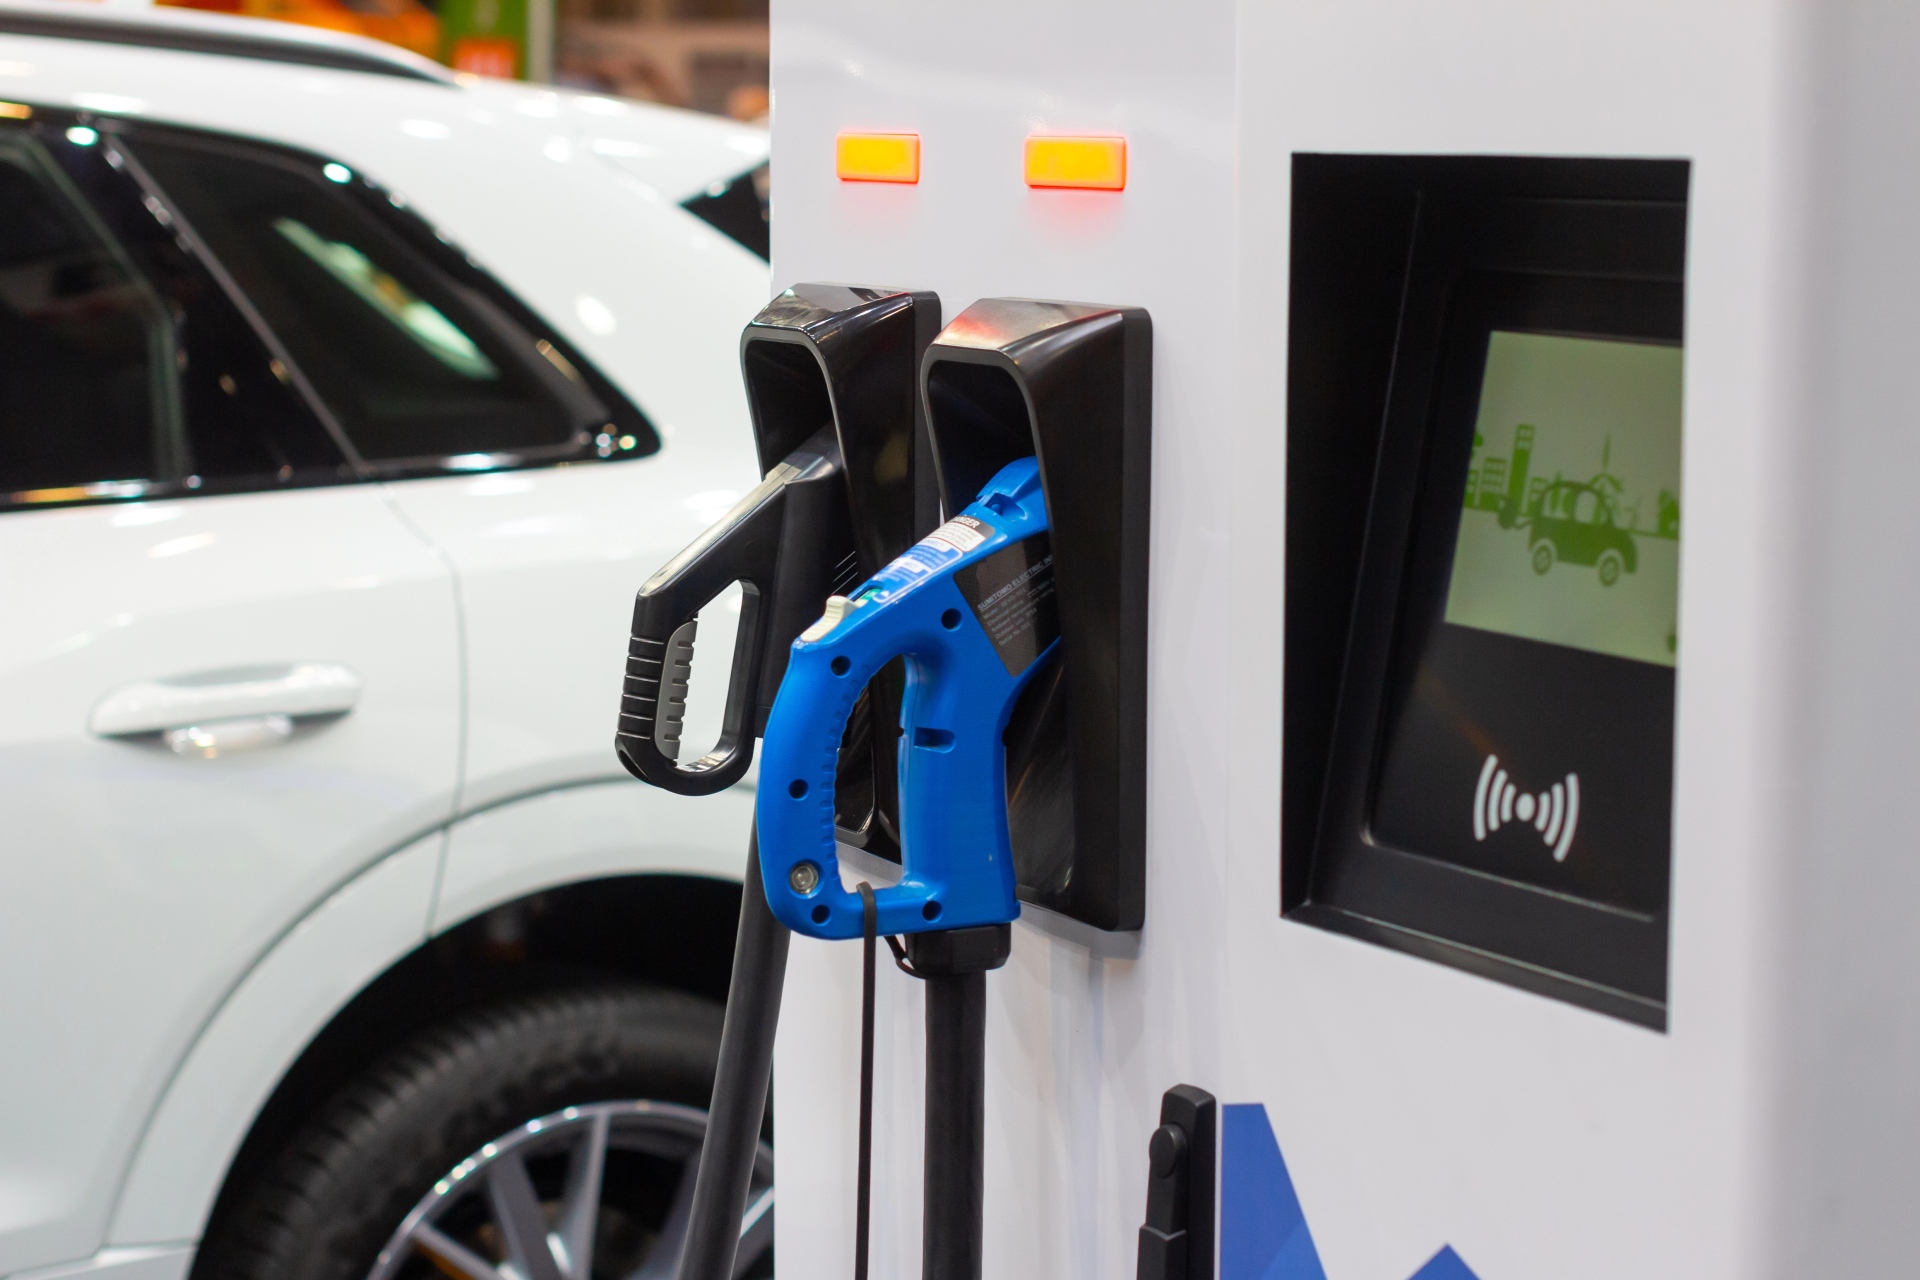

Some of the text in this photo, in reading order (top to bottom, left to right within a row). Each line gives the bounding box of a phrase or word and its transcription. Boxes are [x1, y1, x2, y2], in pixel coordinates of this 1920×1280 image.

[977, 583, 1013, 611] SUMITOMO
[1011, 560, 1044, 586] ELECTRIC
[994, 622, 1015, 639] Outdoor
